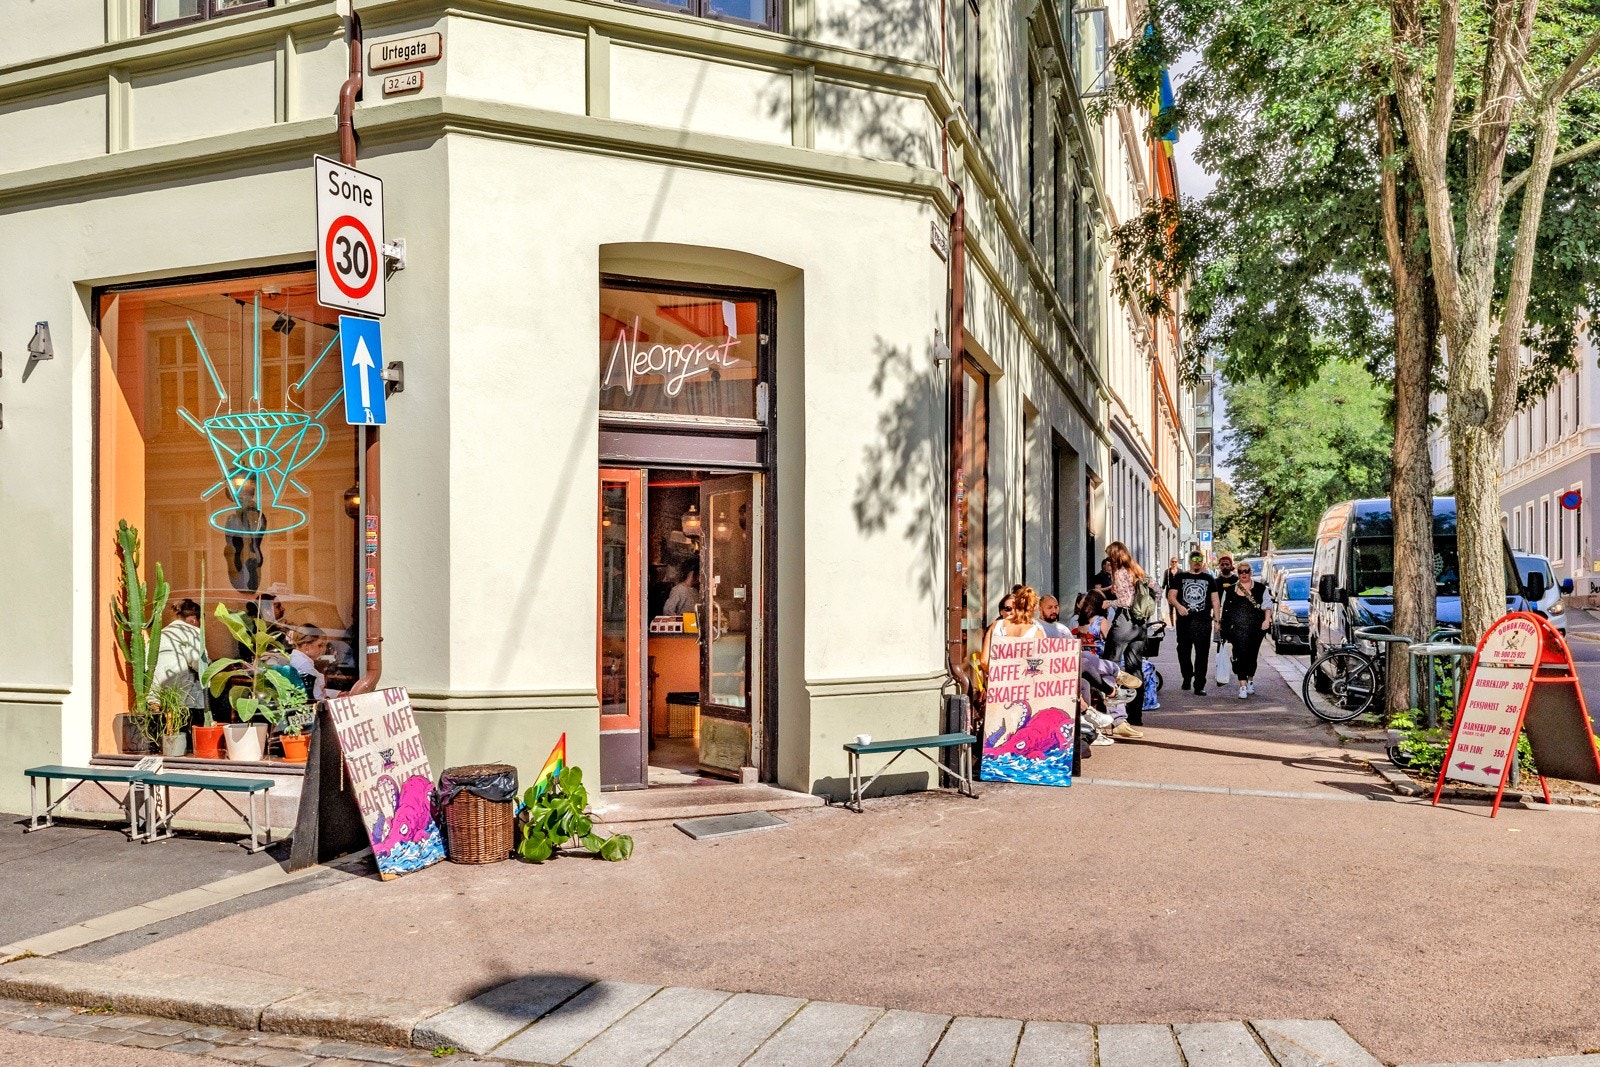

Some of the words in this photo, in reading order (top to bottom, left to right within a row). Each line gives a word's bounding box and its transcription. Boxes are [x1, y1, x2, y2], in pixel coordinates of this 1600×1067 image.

[382, 41, 427, 61] Urtegata
[328, 170, 373, 207] Sone
[336, 235, 369, 279] 30
[604, 315, 741, 396] Neongrut
[1049, 656, 1078, 674] ISKA
[1034, 678, 1078, 699] ISKAFF
[338, 718, 379, 754] KAFFE
[382, 705, 413, 738] KAFF
